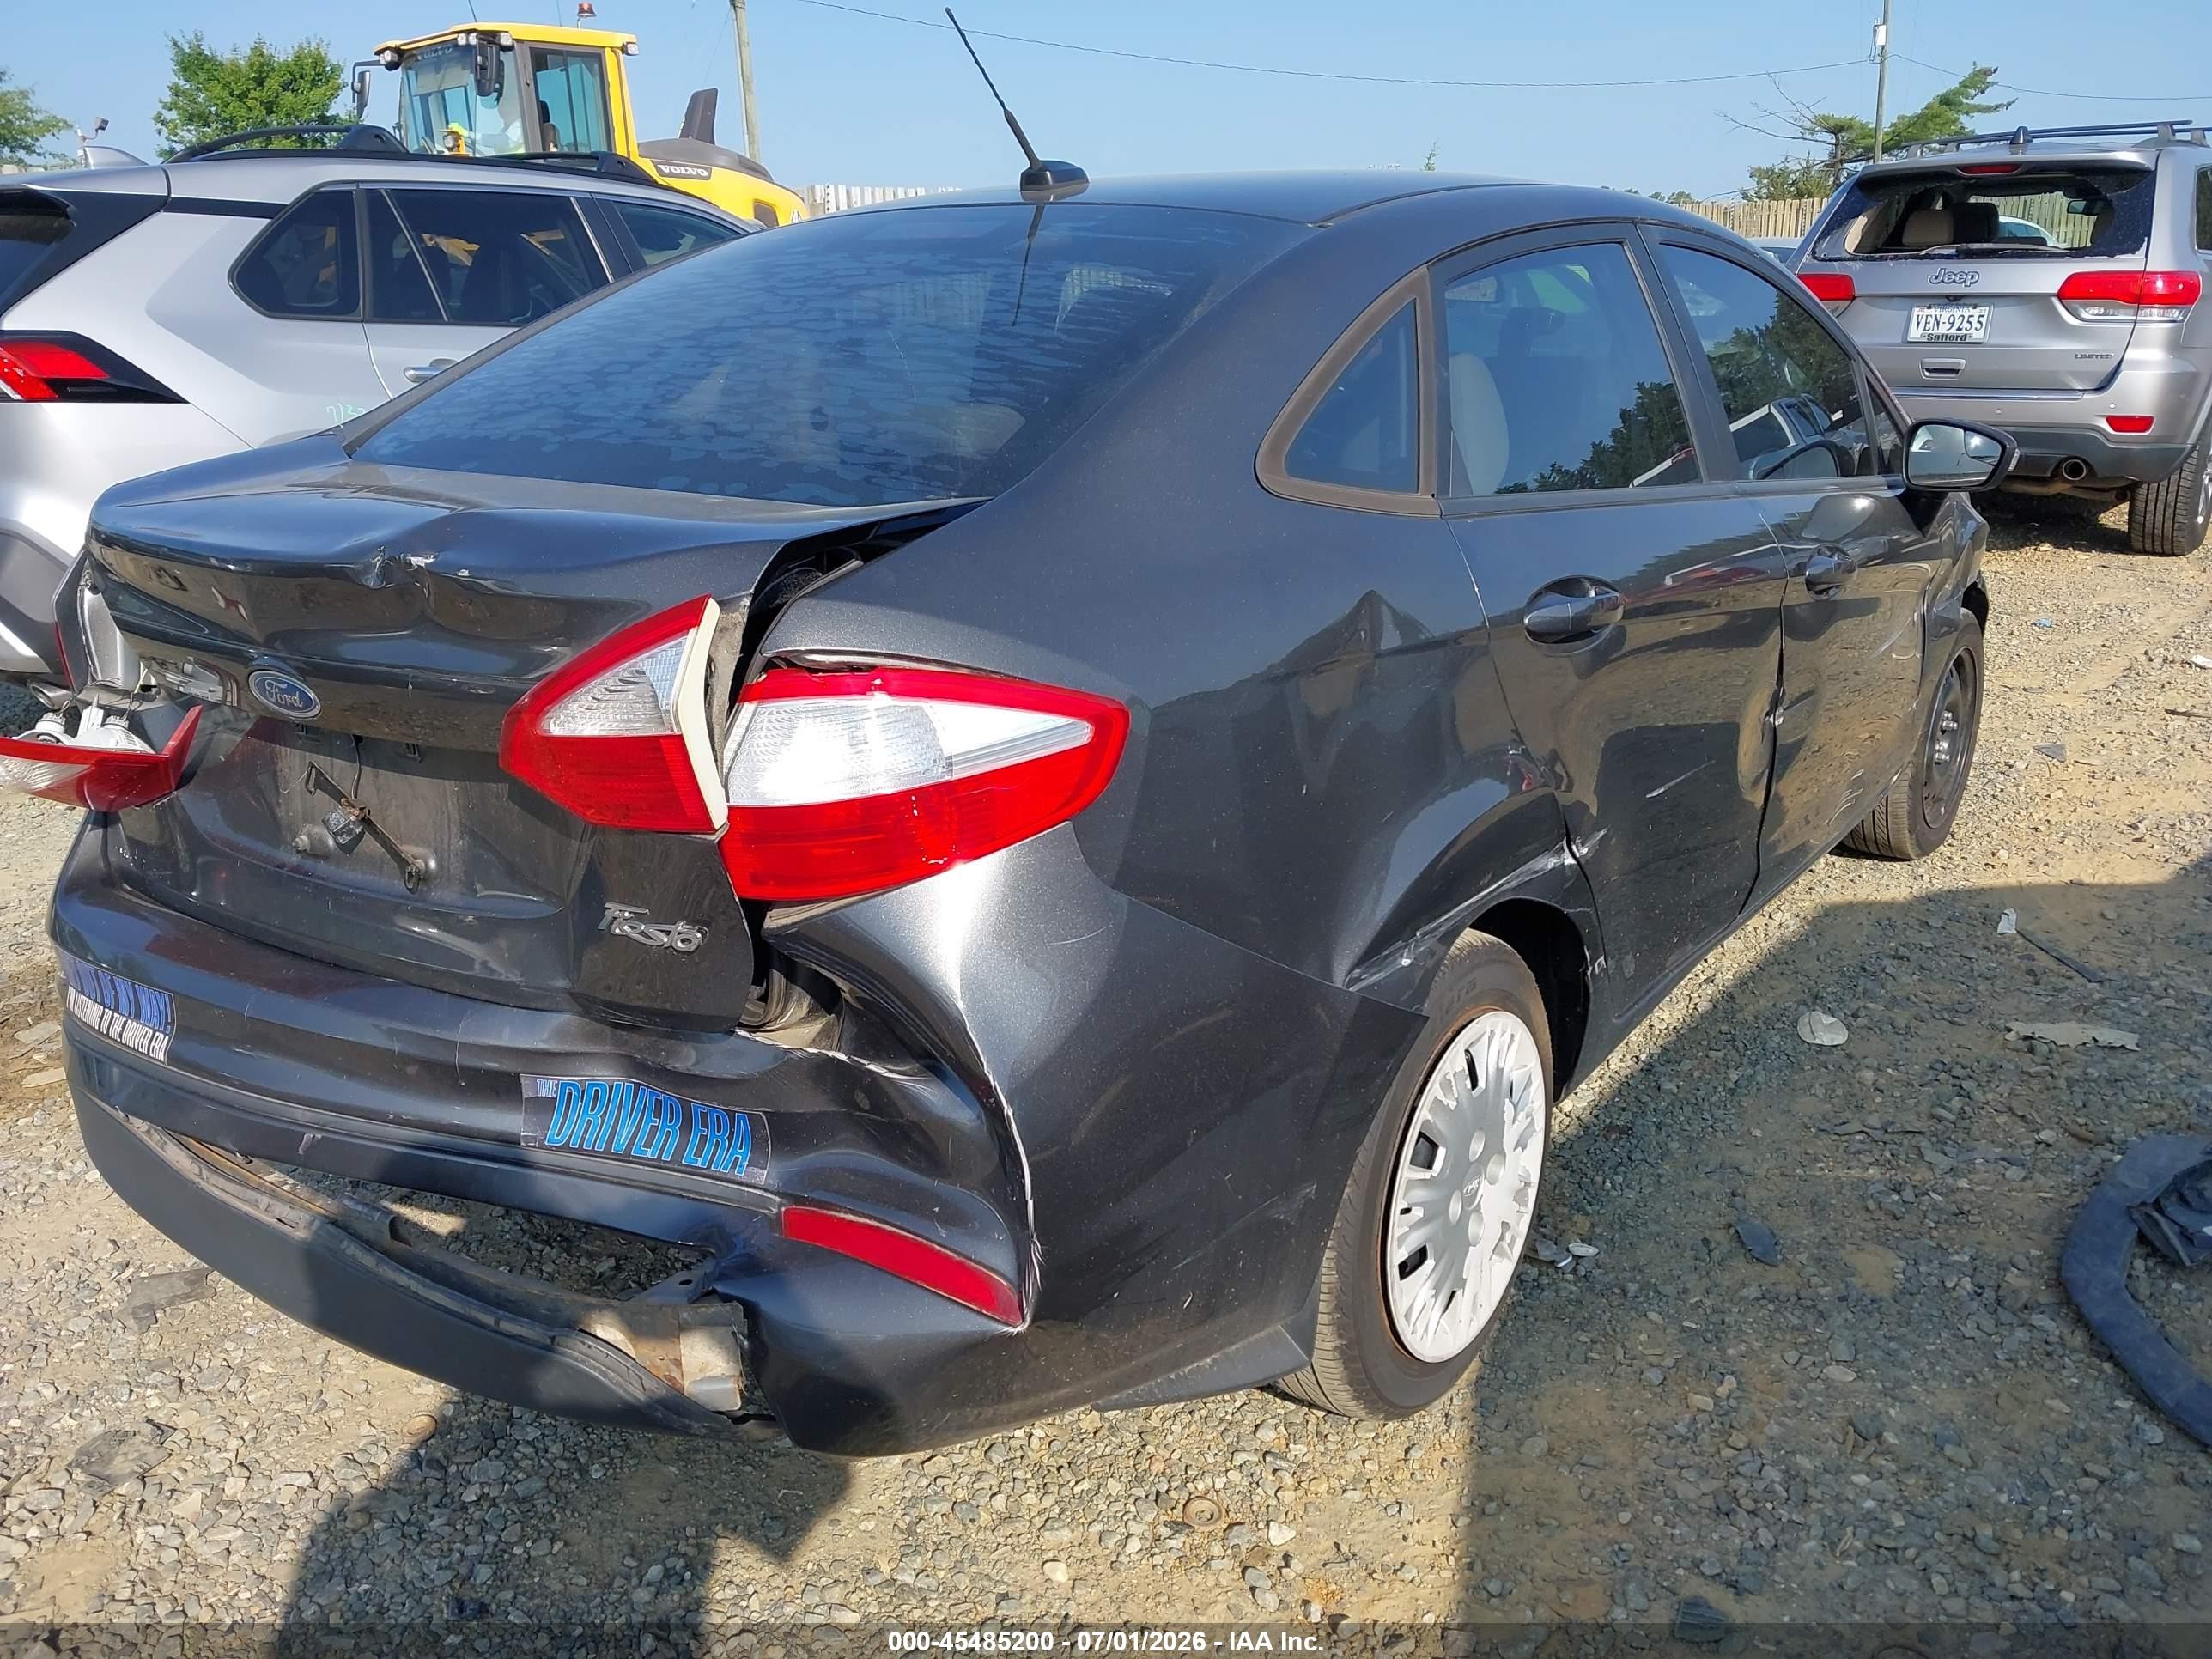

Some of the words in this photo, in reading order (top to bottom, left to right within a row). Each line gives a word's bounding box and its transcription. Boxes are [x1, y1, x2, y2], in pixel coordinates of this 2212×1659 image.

[657, 164, 708, 177] VOLVO
[1927, 267, 1980, 287] Jeep
[1916, 313, 1985, 331] VEN-9255
[264, 679, 303, 708] Ford
[598, 901, 708, 952] Fiesta
[112, 975, 135, 1018] MY
[135, 984, 172, 1034] WAY!
[74, 991, 104, 1030] LISTENING
[100, 1008, 112, 1035] TO
[109, 1012, 127, 1042] THE
[121, 1019, 154, 1054] DRIVER
[149, 1031, 169, 1062] ERA
[537, 1079, 557, 1098] THE
[544, 1080, 684, 1162] DRIVER
[682, 1103, 752, 1176] ERA
